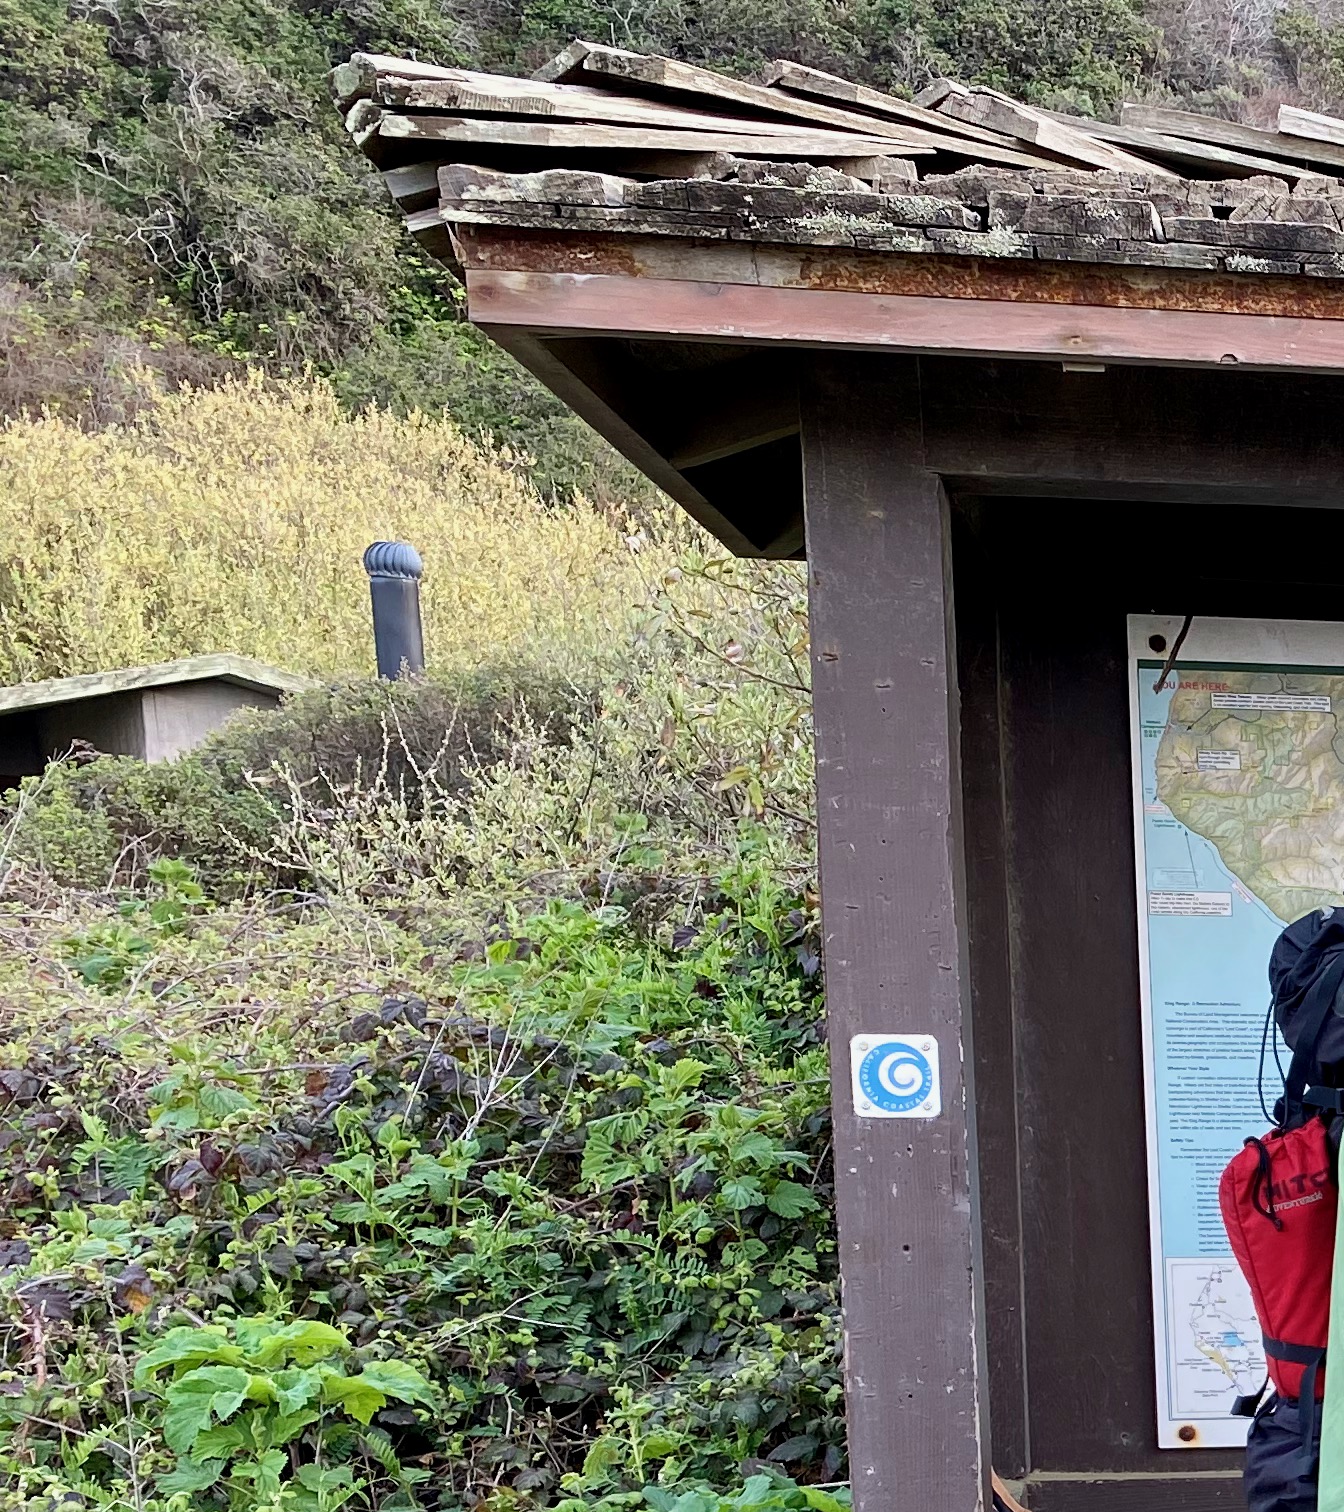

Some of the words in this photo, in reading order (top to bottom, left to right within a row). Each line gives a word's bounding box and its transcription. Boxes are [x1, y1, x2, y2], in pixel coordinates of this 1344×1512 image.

[1154, 681, 1176, 690] OU
[1178, 681, 1199, 690] ARE
[1201, 682, 1229, 691] HERE
[862, 1049, 880, 1102] CALIFORNIA
[883, 1094, 924, 1110] COASTAL
